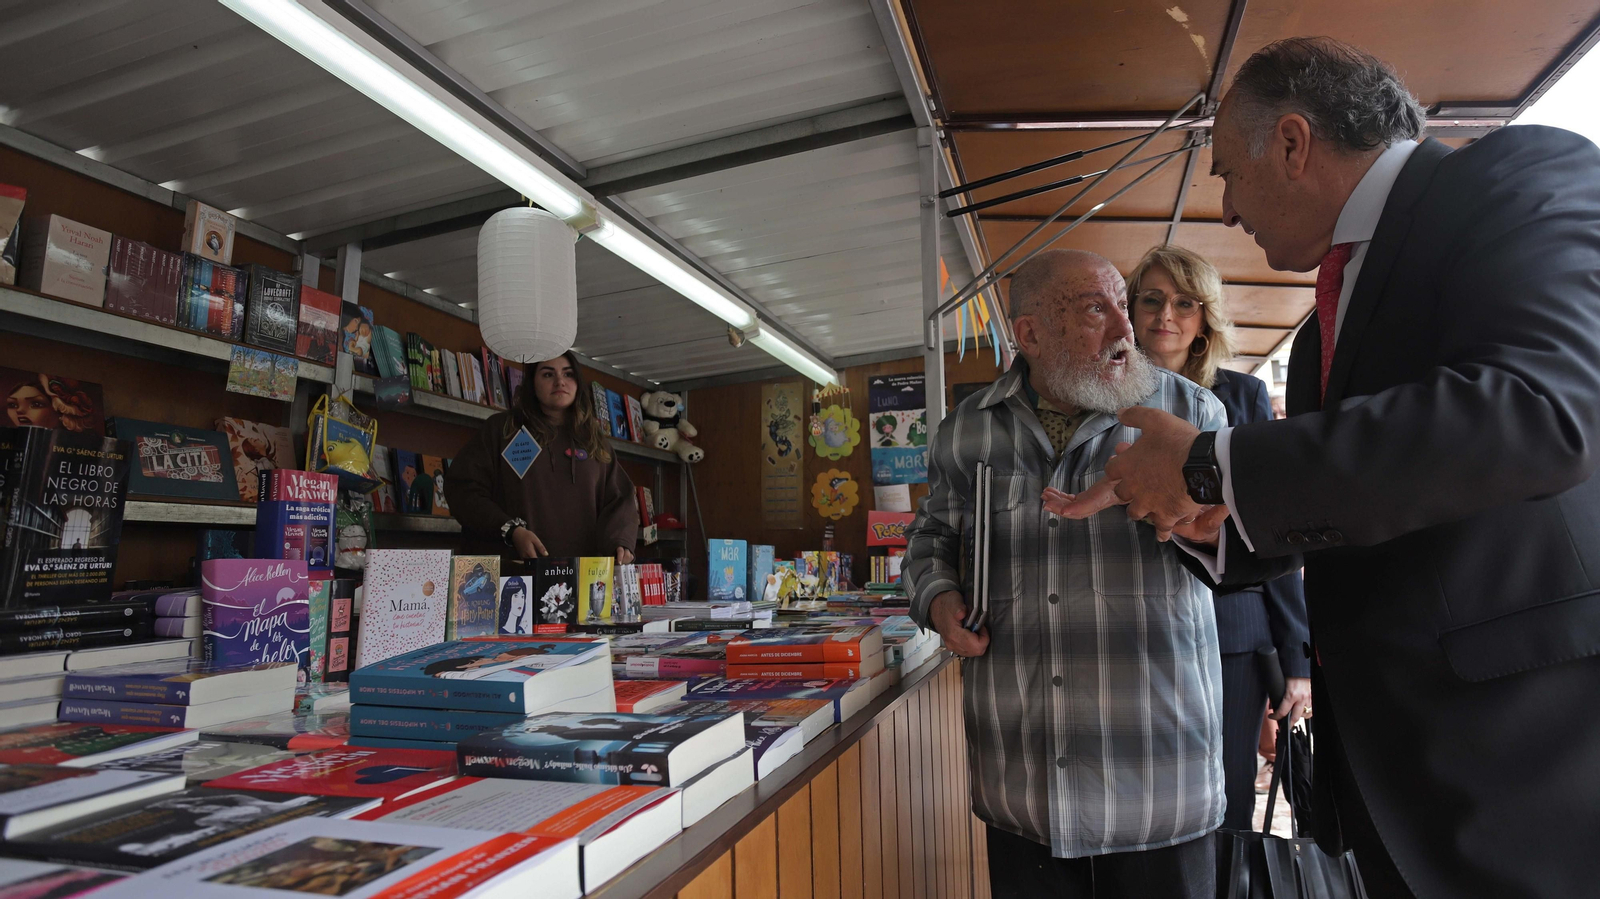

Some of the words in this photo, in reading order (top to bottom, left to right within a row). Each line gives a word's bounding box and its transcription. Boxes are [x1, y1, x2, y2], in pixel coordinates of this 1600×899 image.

[61, 224, 82, 237] Yuval
[84, 232, 104, 244] Noah
[70, 236, 94, 249] Harari
[264, 288, 292, 298] LOVECRAFT
[76, 448, 97, 457] SÁENZ
[107, 452, 124, 461] URTURI
[152, 454, 174, 471] LA
[176, 452, 211, 468] CITA
[59, 461, 72, 474] EL
[79, 463, 114, 478] LIBRO
[47, 476, 99, 492] NEGRO
[104, 482, 119, 494] DE
[291, 474, 330, 491] Megan
[43, 492, 68, 506] LAS
[73, 494, 118, 509] HORAS
[286, 486, 335, 502] Maxwell
[311, 505, 331, 513] erótica
[871, 521, 906, 541] Poké
[24, 564, 41, 572] EVA
[54, 562, 77, 570] SÁENZ
[544, 566, 574, 576] anhelo
[588, 568, 608, 577] fulgor
[241, 566, 266, 587] Alice
[266, 563, 292, 581] Kellen
[253, 598, 266, 617] El
[389, 598, 430, 612] Mamá,
[15, 612, 38, 620] HORAS
[20, 635, 42, 643] HORAS
[272, 632, 284, 643] los
[250, 639, 261, 652] de
[69, 684, 94, 692] Maxwell
[94, 684, 116, 694] Megan
[388, 688, 417, 696] HIPÓTESIS
[453, 691, 489, 699] HAZELWOOD
[65, 706, 90, 716] Maxwell
[90, 708, 111, 718] Megan
[390, 720, 418, 728] HIPÓTESIS
[464, 755, 505, 768] Maxwell
[506, 756, 540, 770] Megan
[465, 836, 539, 874] FRANZEN
